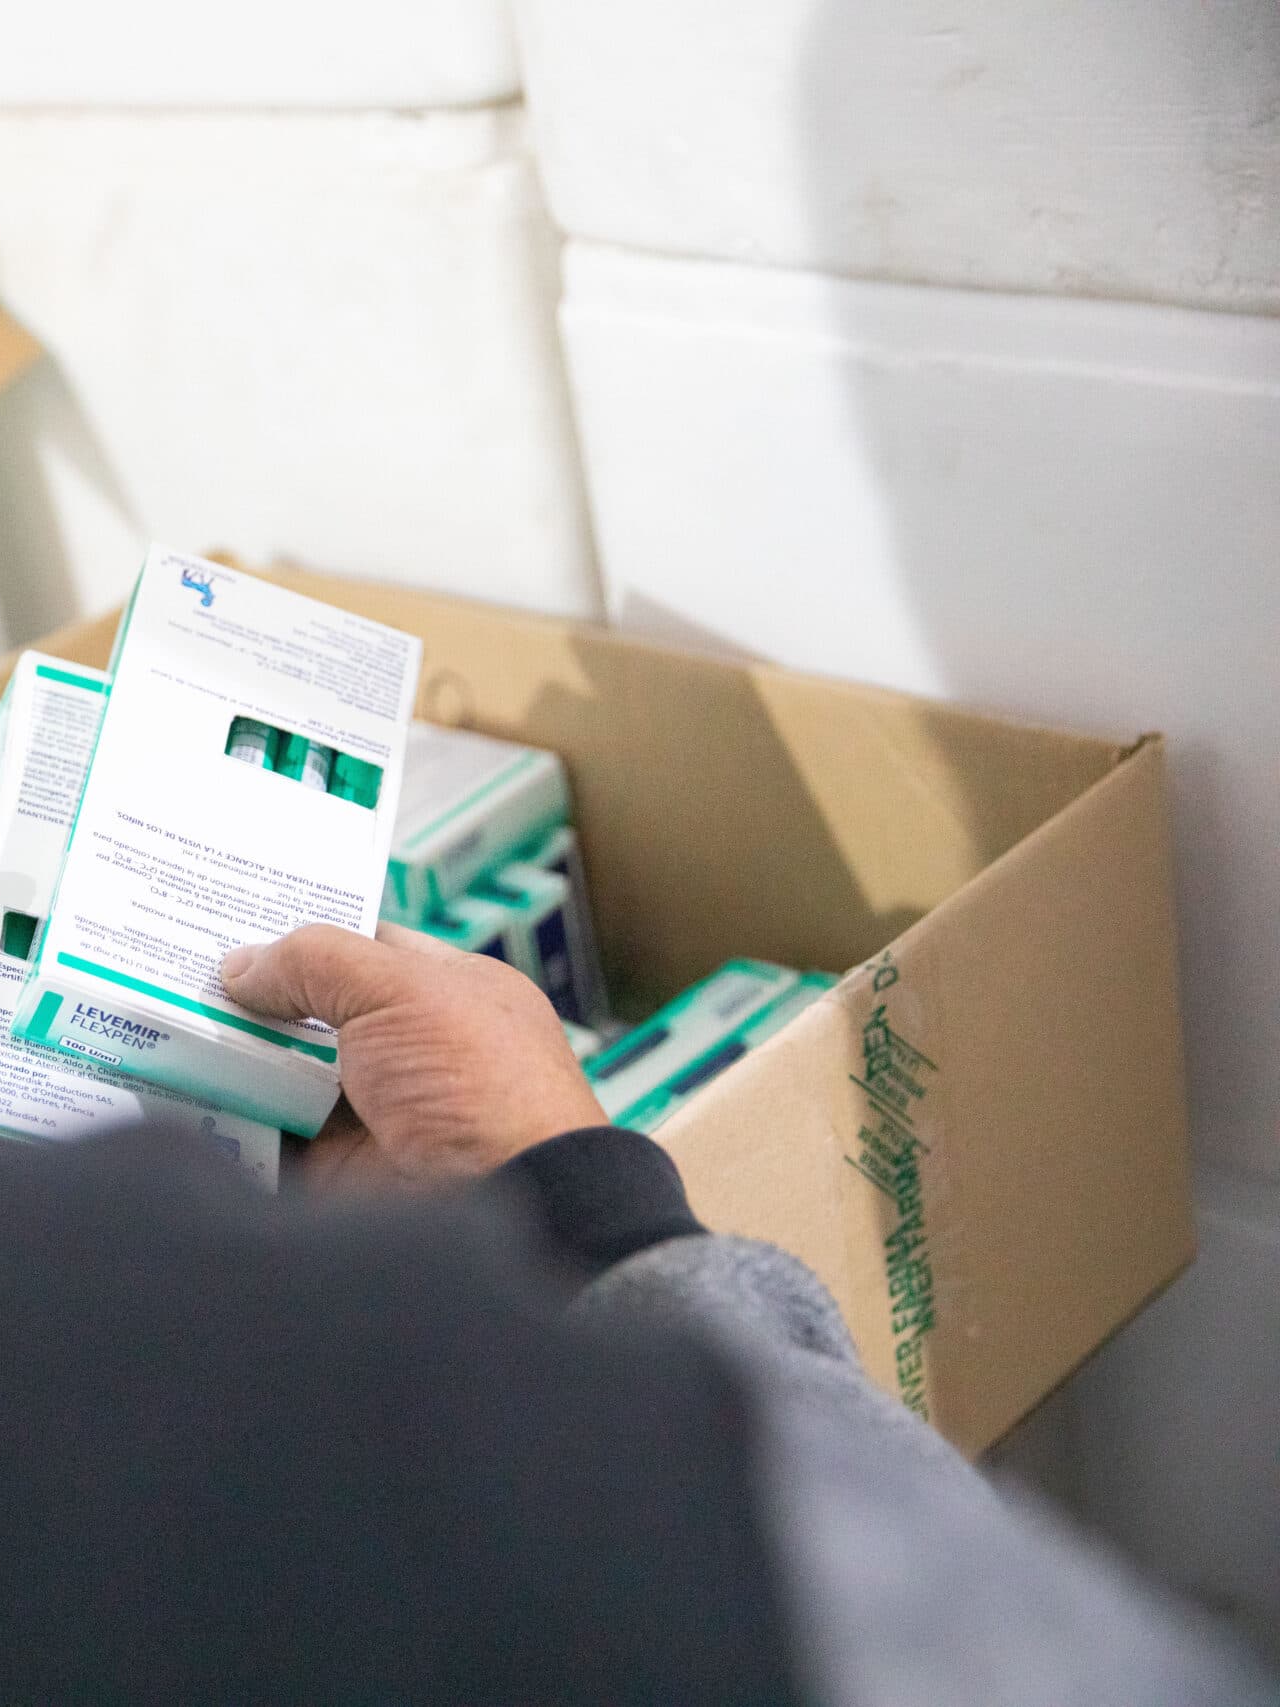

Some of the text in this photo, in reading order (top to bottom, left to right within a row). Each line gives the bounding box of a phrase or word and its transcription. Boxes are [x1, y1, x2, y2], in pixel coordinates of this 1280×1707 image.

[144, 822, 162, 834] LOS
[164, 830, 175, 839] DE
[91, 830, 112, 843] para
[176, 835, 202, 849] VISTA
[94, 850, 110, 862] por
[111, 838, 151, 859] colocado
[194, 852, 200, 860] 3
[202, 845, 215, 854] LA
[110, 858, 153, 880] Conservar
[150, 854, 185, 873] lapicera
[207, 856, 258, 880] prellenadas
[225, 852, 265, 871] ALCANCE
[158, 869, 197, 889] heladera
[185, 869, 195, 877] la
[195, 872, 207, 882] de
[266, 866, 283, 877] DEL
[285, 871, 313, 887] FUERA
[197, 884, 209, 892] en
[208, 875, 250, 897] capuchón
[258, 873, 297, 893] lapiceras
[192, 890, 199, 898] 6
[200, 893, 213, 903] las
[210, 888, 260, 911] conservarse
[251, 891, 260, 900] el
[314, 880, 364, 904] MANTENER
[214, 898, 225, 907] de
[261, 893, 304, 914] Mantener
[292, 896, 301, 904] la
[302, 899, 314, 908] de
[194, 902, 234, 921] heladera
[227, 902, 257, 918] dentro
[260, 905, 288, 920] Puede
[234, 916, 246, 925] en
[258, 912, 289, 928] utilizar
[346, 919, 360, 930] No
[74, 922, 106, 940] fosfato
[174, 916, 230, 942] transparente
[78, 940, 91, 950] de
[128, 943, 141, 953] de
[172, 942, 192, 955] para
[142, 948, 174, 965] acetato
[163, 948, 187, 963] ácido
[193, 950, 216, 964] agua
[143, 964, 160, 976] 100
[161, 971, 200, 990] contiene
[10, 1035, 22, 1044] de
[23, 1038, 56, 1053] Buenos
[64, 1039, 117, 1063] 100 U/ml
[22, 1055, 33, 1064] de
[35, 1057, 75, 1076] Atención
[77, 1069, 85, 1078] al
[62, 1057, 83, 1069] Aldo
[9, 1070, 43, 1087] Nordisk
[45, 1080, 93, 1101] Production
[20, 1092, 60, 1109] Chartres,
[62, 1102, 95, 1118] Francia
[4, 1107, 39, 1123] Nordisk
